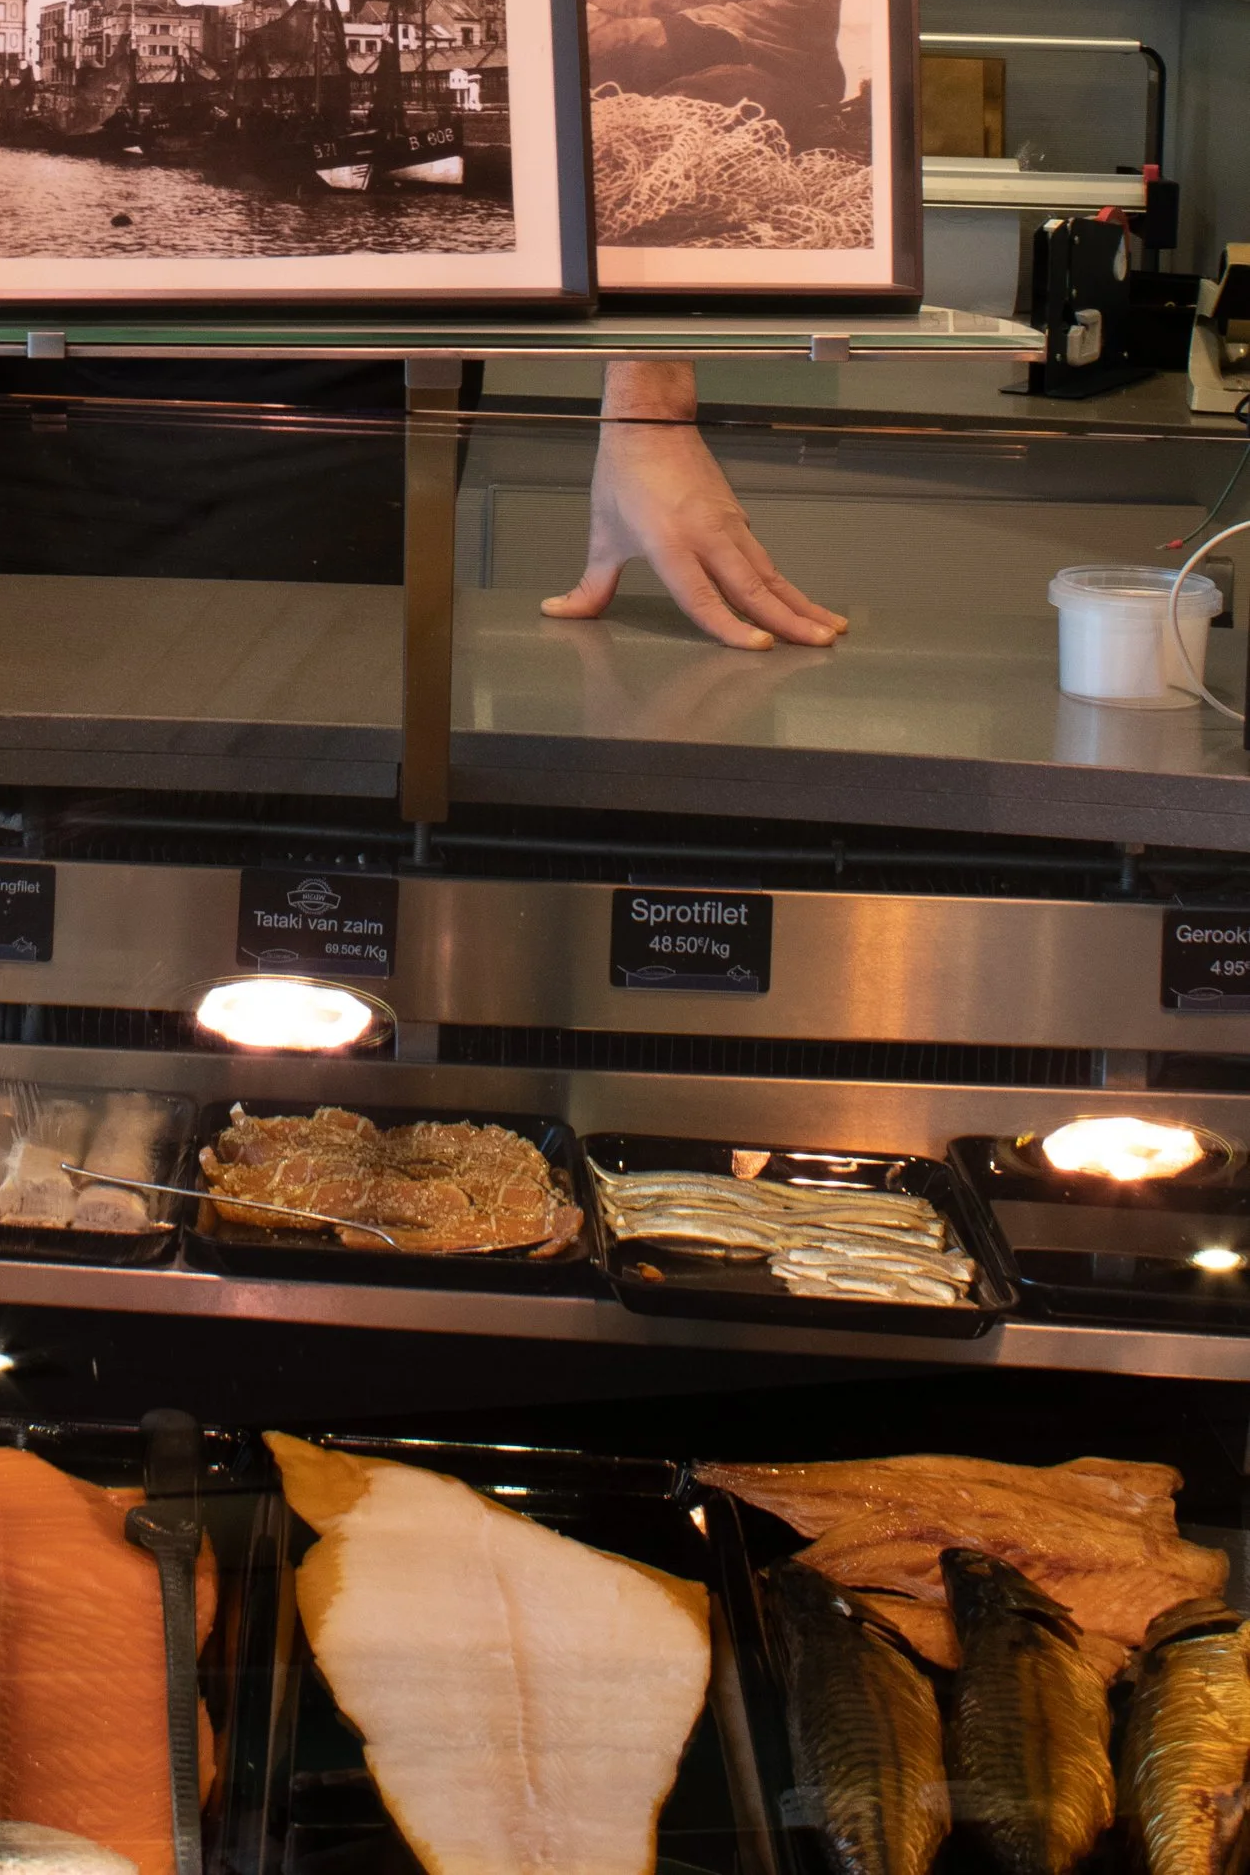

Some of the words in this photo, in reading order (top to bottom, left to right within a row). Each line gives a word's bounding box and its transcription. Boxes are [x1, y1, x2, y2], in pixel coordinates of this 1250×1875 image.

[254, 911, 302, 929] Tataki
[307, 917, 338, 932] van
[343, 919, 383, 935] zalm
[631, 898, 749, 926] Sprotfilet
